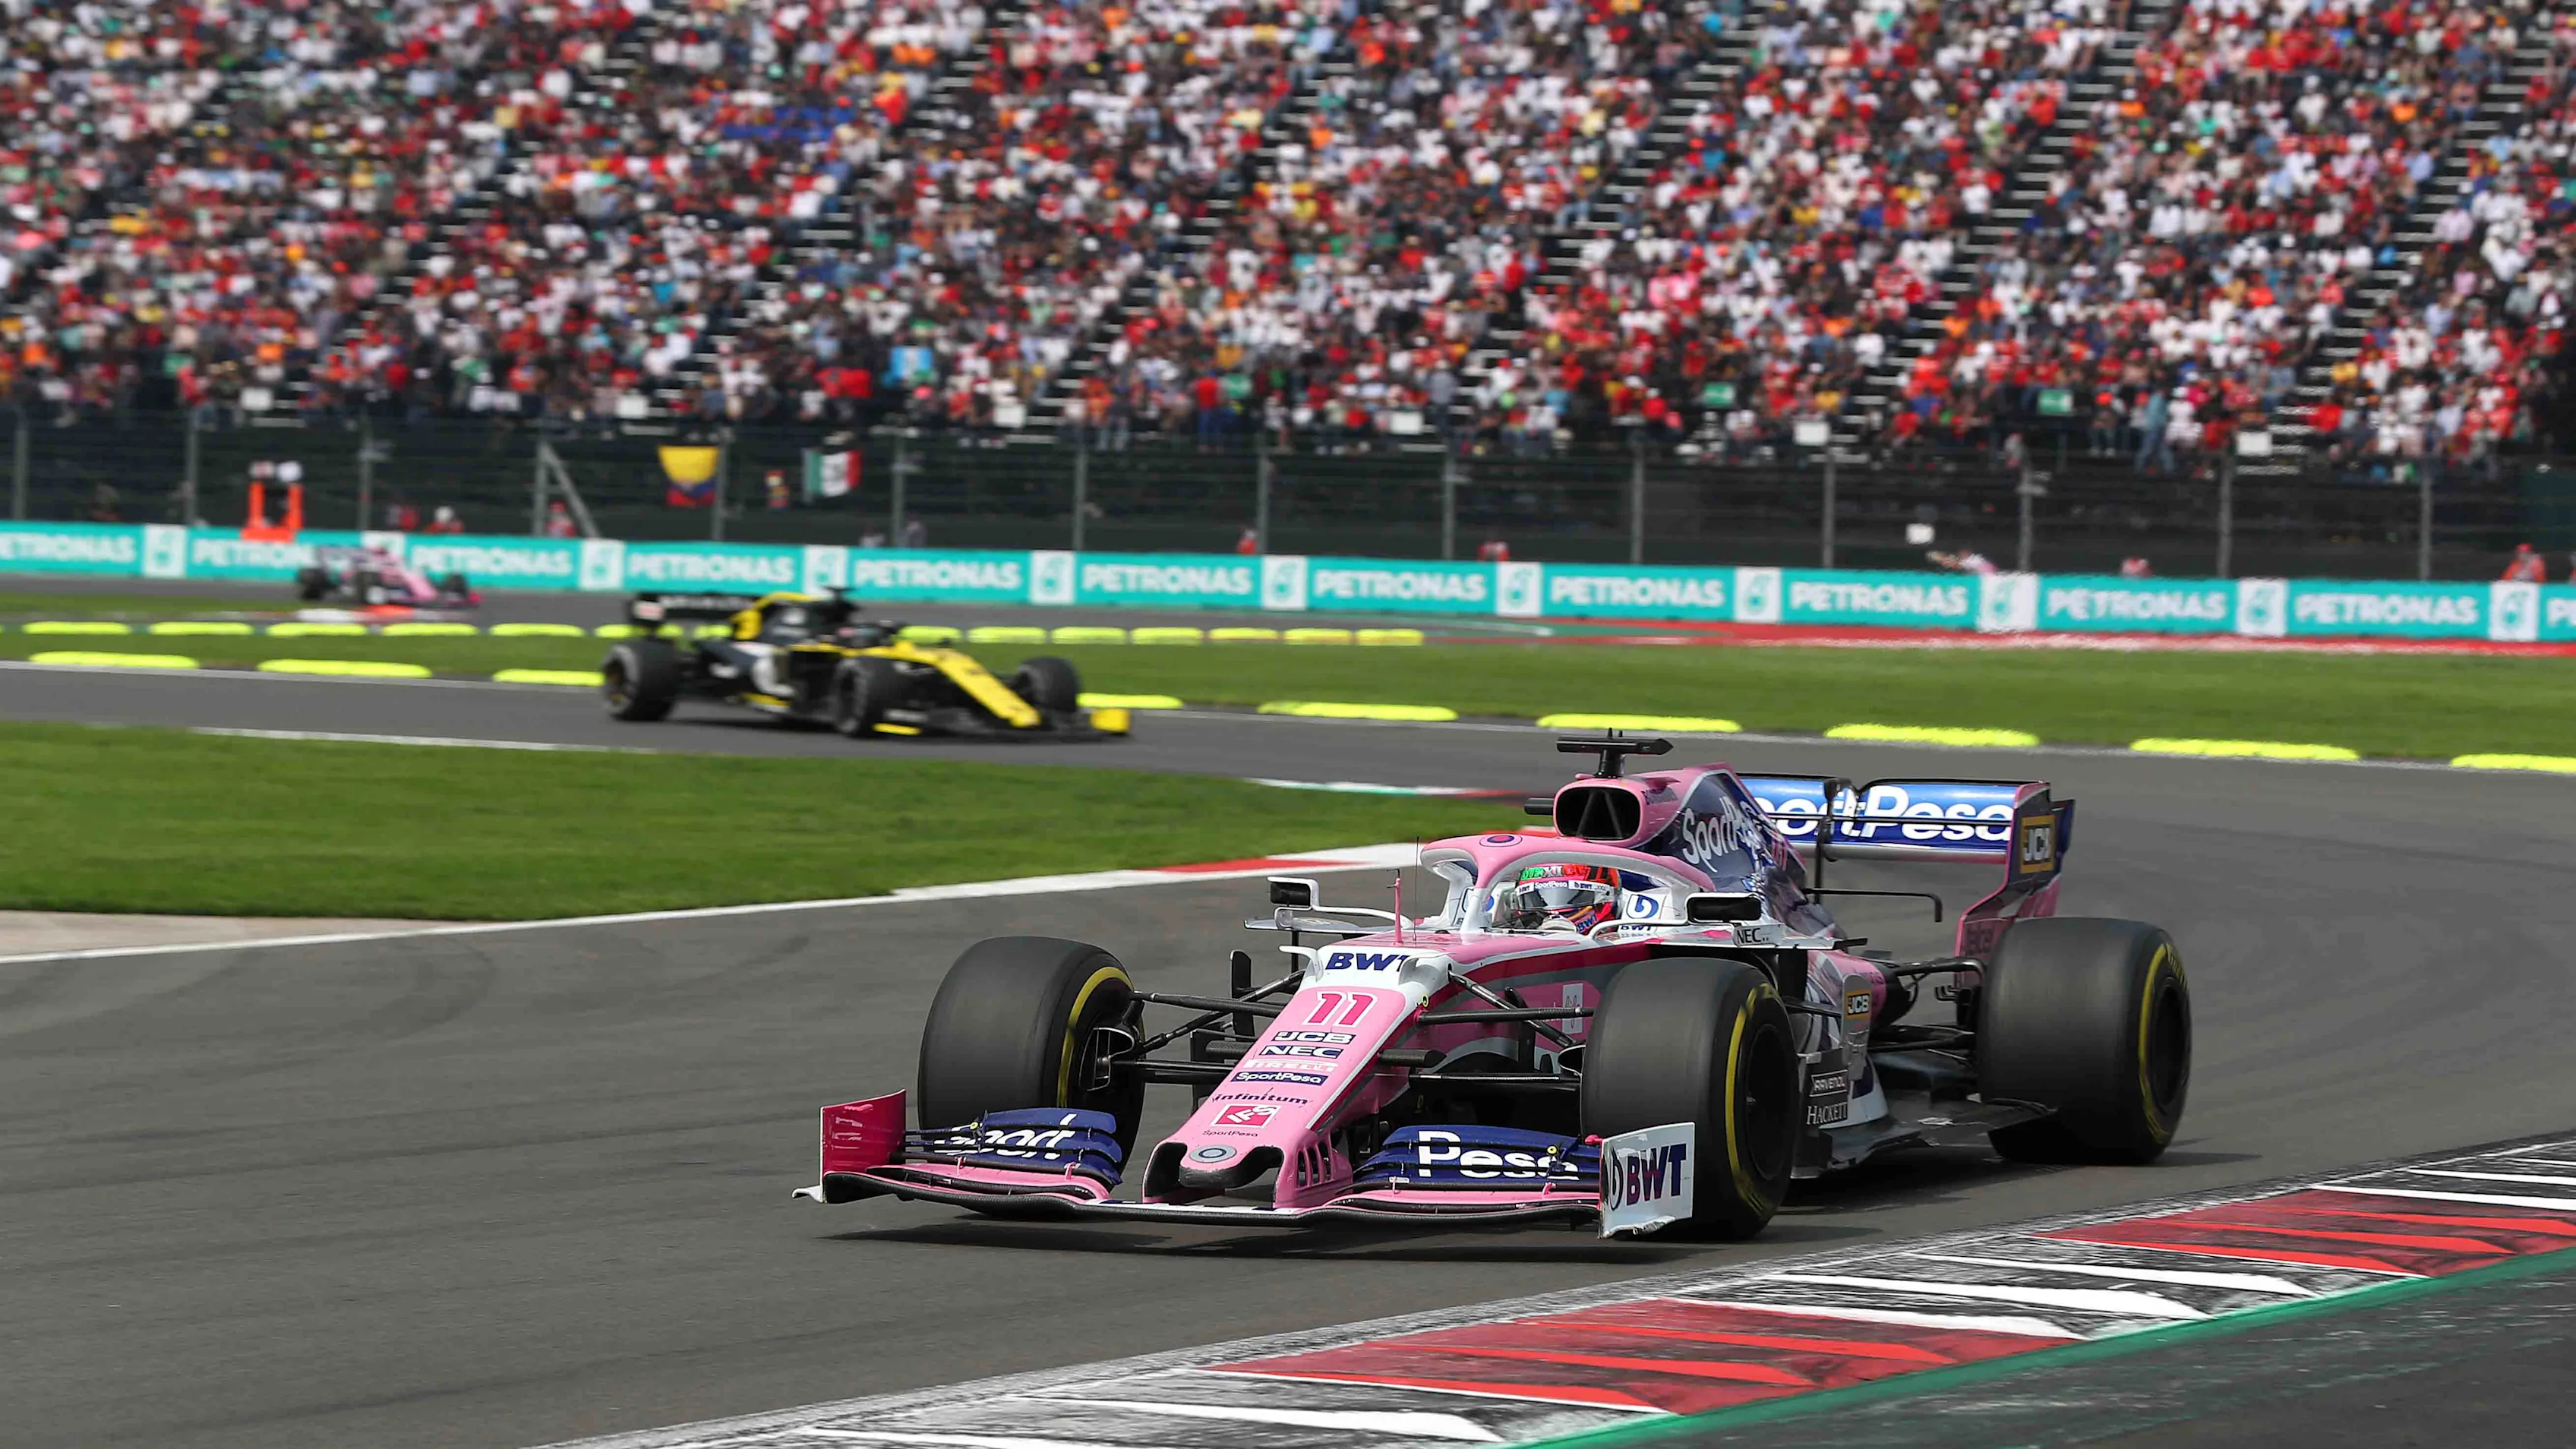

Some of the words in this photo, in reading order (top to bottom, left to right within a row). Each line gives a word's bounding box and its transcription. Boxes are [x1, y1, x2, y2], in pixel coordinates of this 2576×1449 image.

[0, 532, 136, 563] ETRONAS
[412, 545, 573, 575] PETRONAS
[629, 553, 794, 584] PETRONAS
[854, 559, 1021, 589] PETRONAS
[1082, 564, 1252, 594] PETRONAS
[1313, 569, 1486, 601] PETRONAS
[1550, 576, 1725, 607] PETRONAS
[1790, 581, 1968, 615] PETRONAS
[2047, 588, 2226, 620] PETRONAS
[2295, 592, 2478, 624] PETRONAS
[1302, 991, 1378, 1028] 11
[1848, 995, 1869, 1015] JCB
[1261, 1045, 1344, 1059] NEC
[1274, 1031, 1354, 1044] JCB
[1236, 1072, 1323, 1084] SportPesa
[1242, 1059, 1339, 1073] PIRELLI
[1215, 1093, 1309, 1105] infinitum
[1806, 1103, 1848, 1125] HACKETT
[1226, 1106, 1280, 1124] IFS
[1202, 1129, 1258, 1138] SportPesa
[1627, 1144, 1686, 1206] BWT
